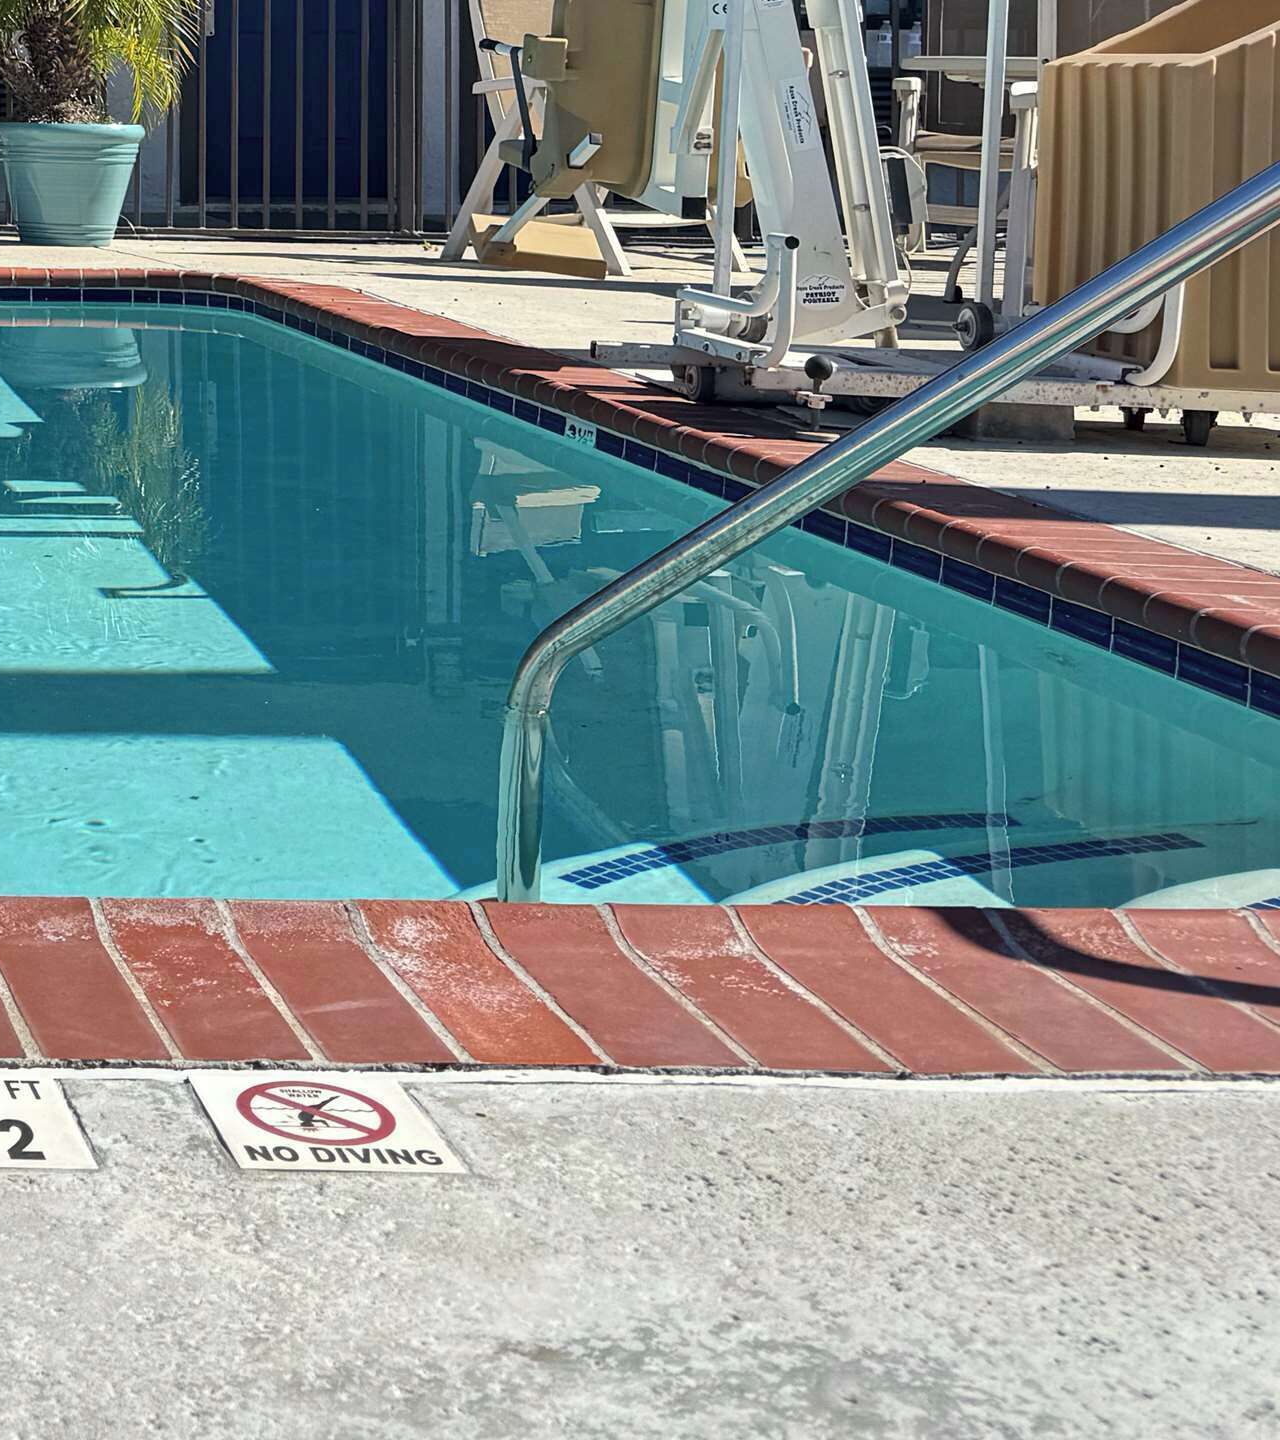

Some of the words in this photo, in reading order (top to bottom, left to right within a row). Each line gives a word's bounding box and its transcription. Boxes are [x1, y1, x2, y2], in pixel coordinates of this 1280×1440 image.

[4, 1079, 42, 1101] FT
[243, 1145, 300, 1162] NO
[309, 1146, 444, 1166] DIVING
